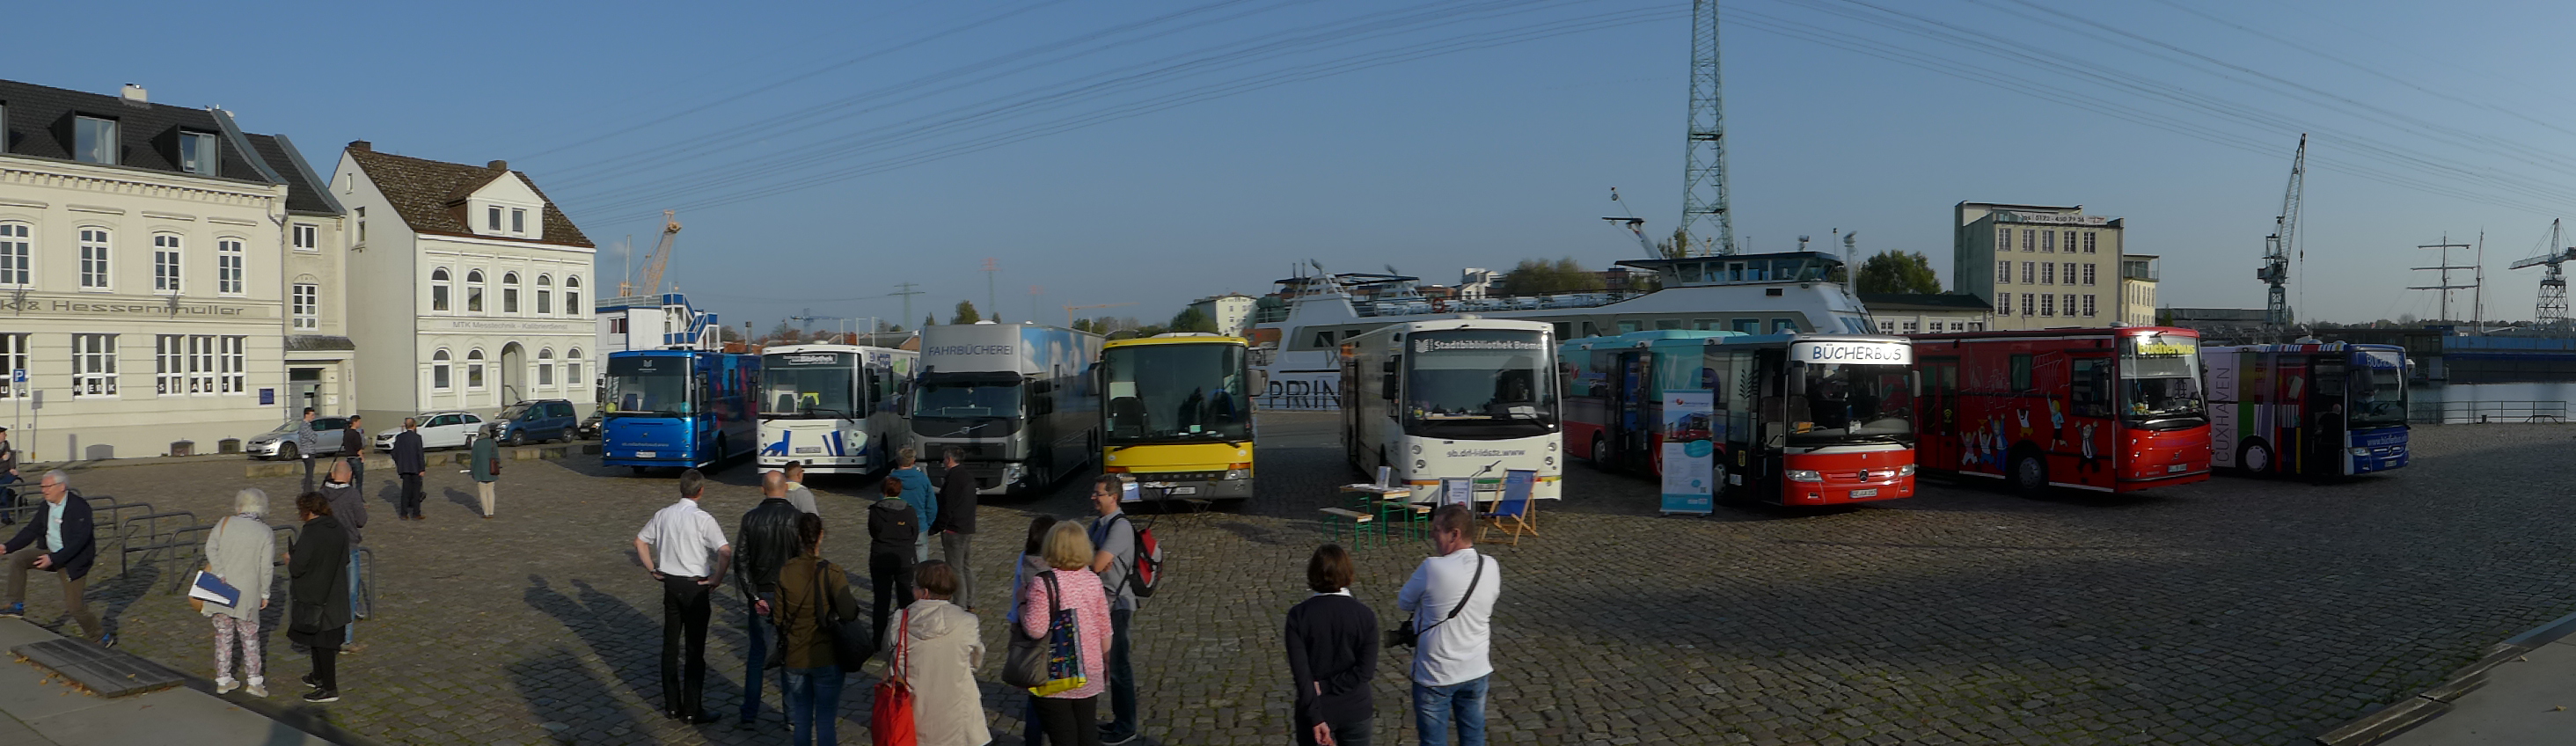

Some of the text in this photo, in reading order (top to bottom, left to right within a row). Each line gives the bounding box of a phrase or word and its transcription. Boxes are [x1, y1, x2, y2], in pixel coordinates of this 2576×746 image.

[52, 300, 244, 316] Hessenmüller
[928, 343, 1014, 355] FAHRBÜCHEREI
[1812, 343, 1901, 361] BÜCHERBUS
[14, 370, 24, 382] P
[2215, 368, 2229, 462] CUXHAVEN
